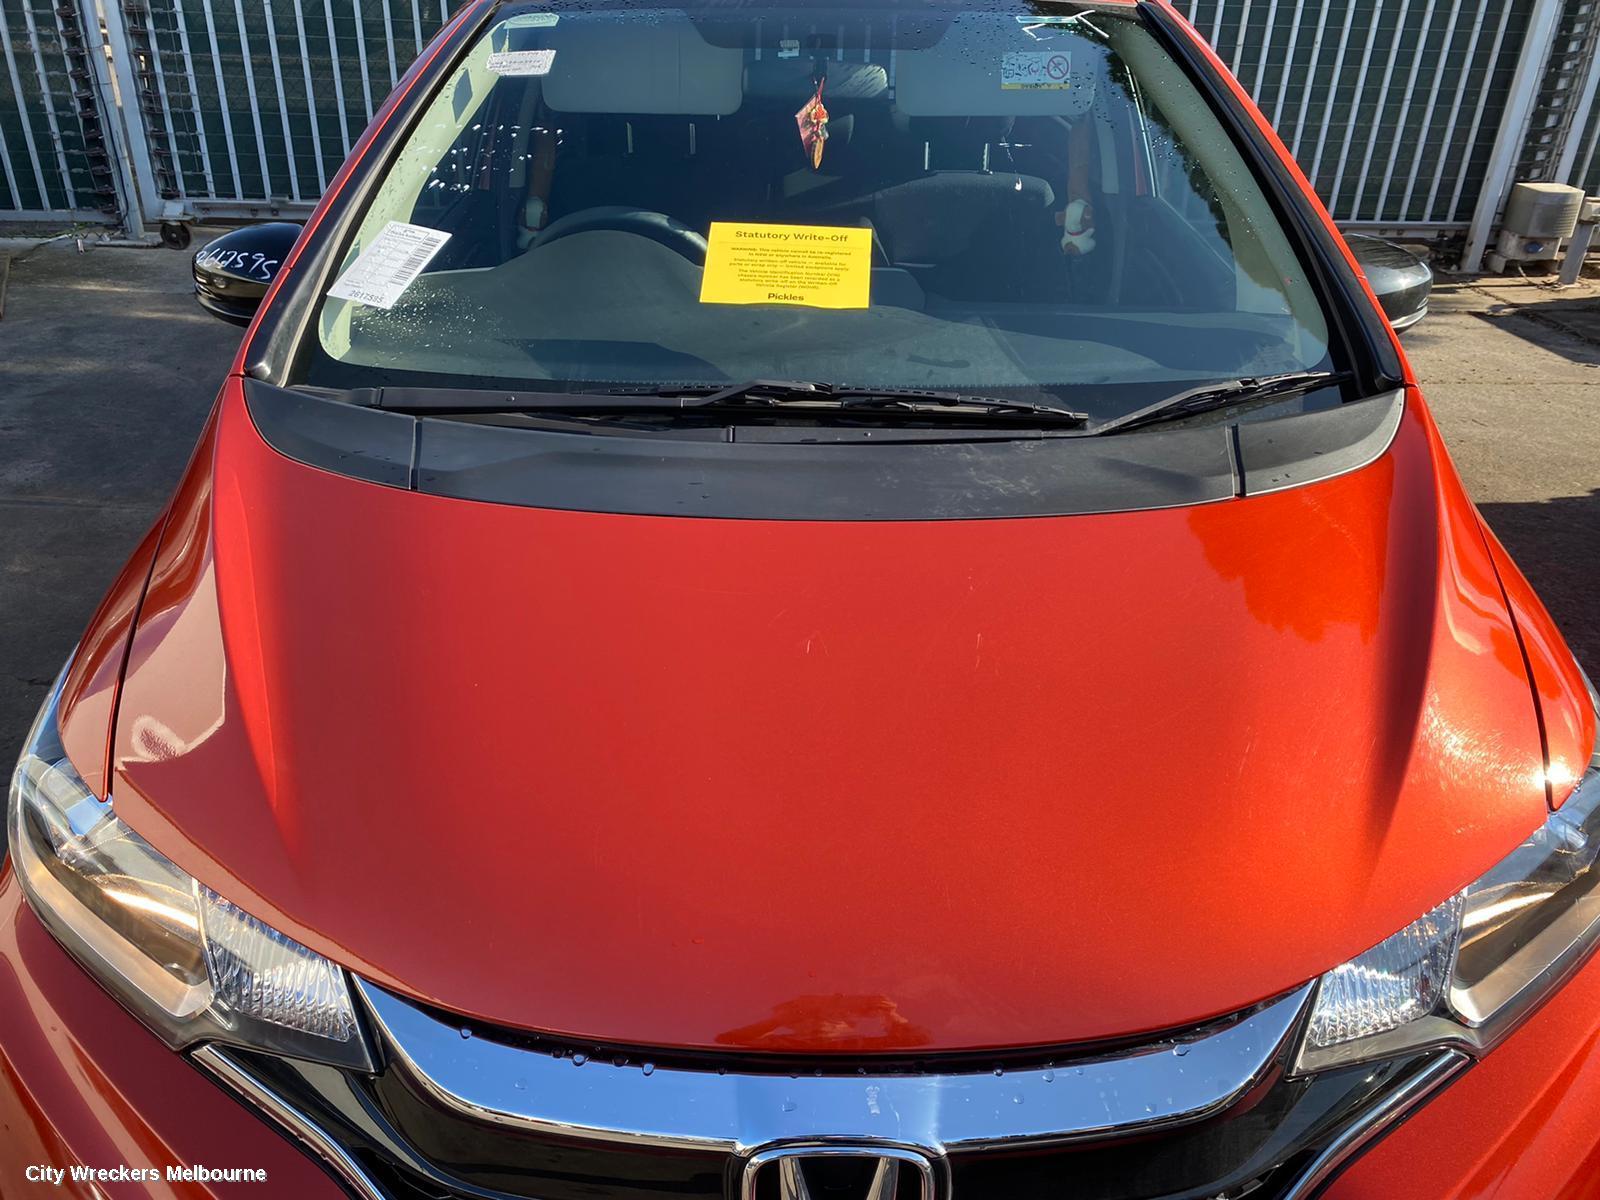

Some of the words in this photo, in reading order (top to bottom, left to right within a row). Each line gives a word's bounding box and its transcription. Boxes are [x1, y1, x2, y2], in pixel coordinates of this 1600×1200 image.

[735, 230, 790, 241] Statutory
[793, 233, 849, 242] Write-Off
[767, 292, 805, 301] Pickles
